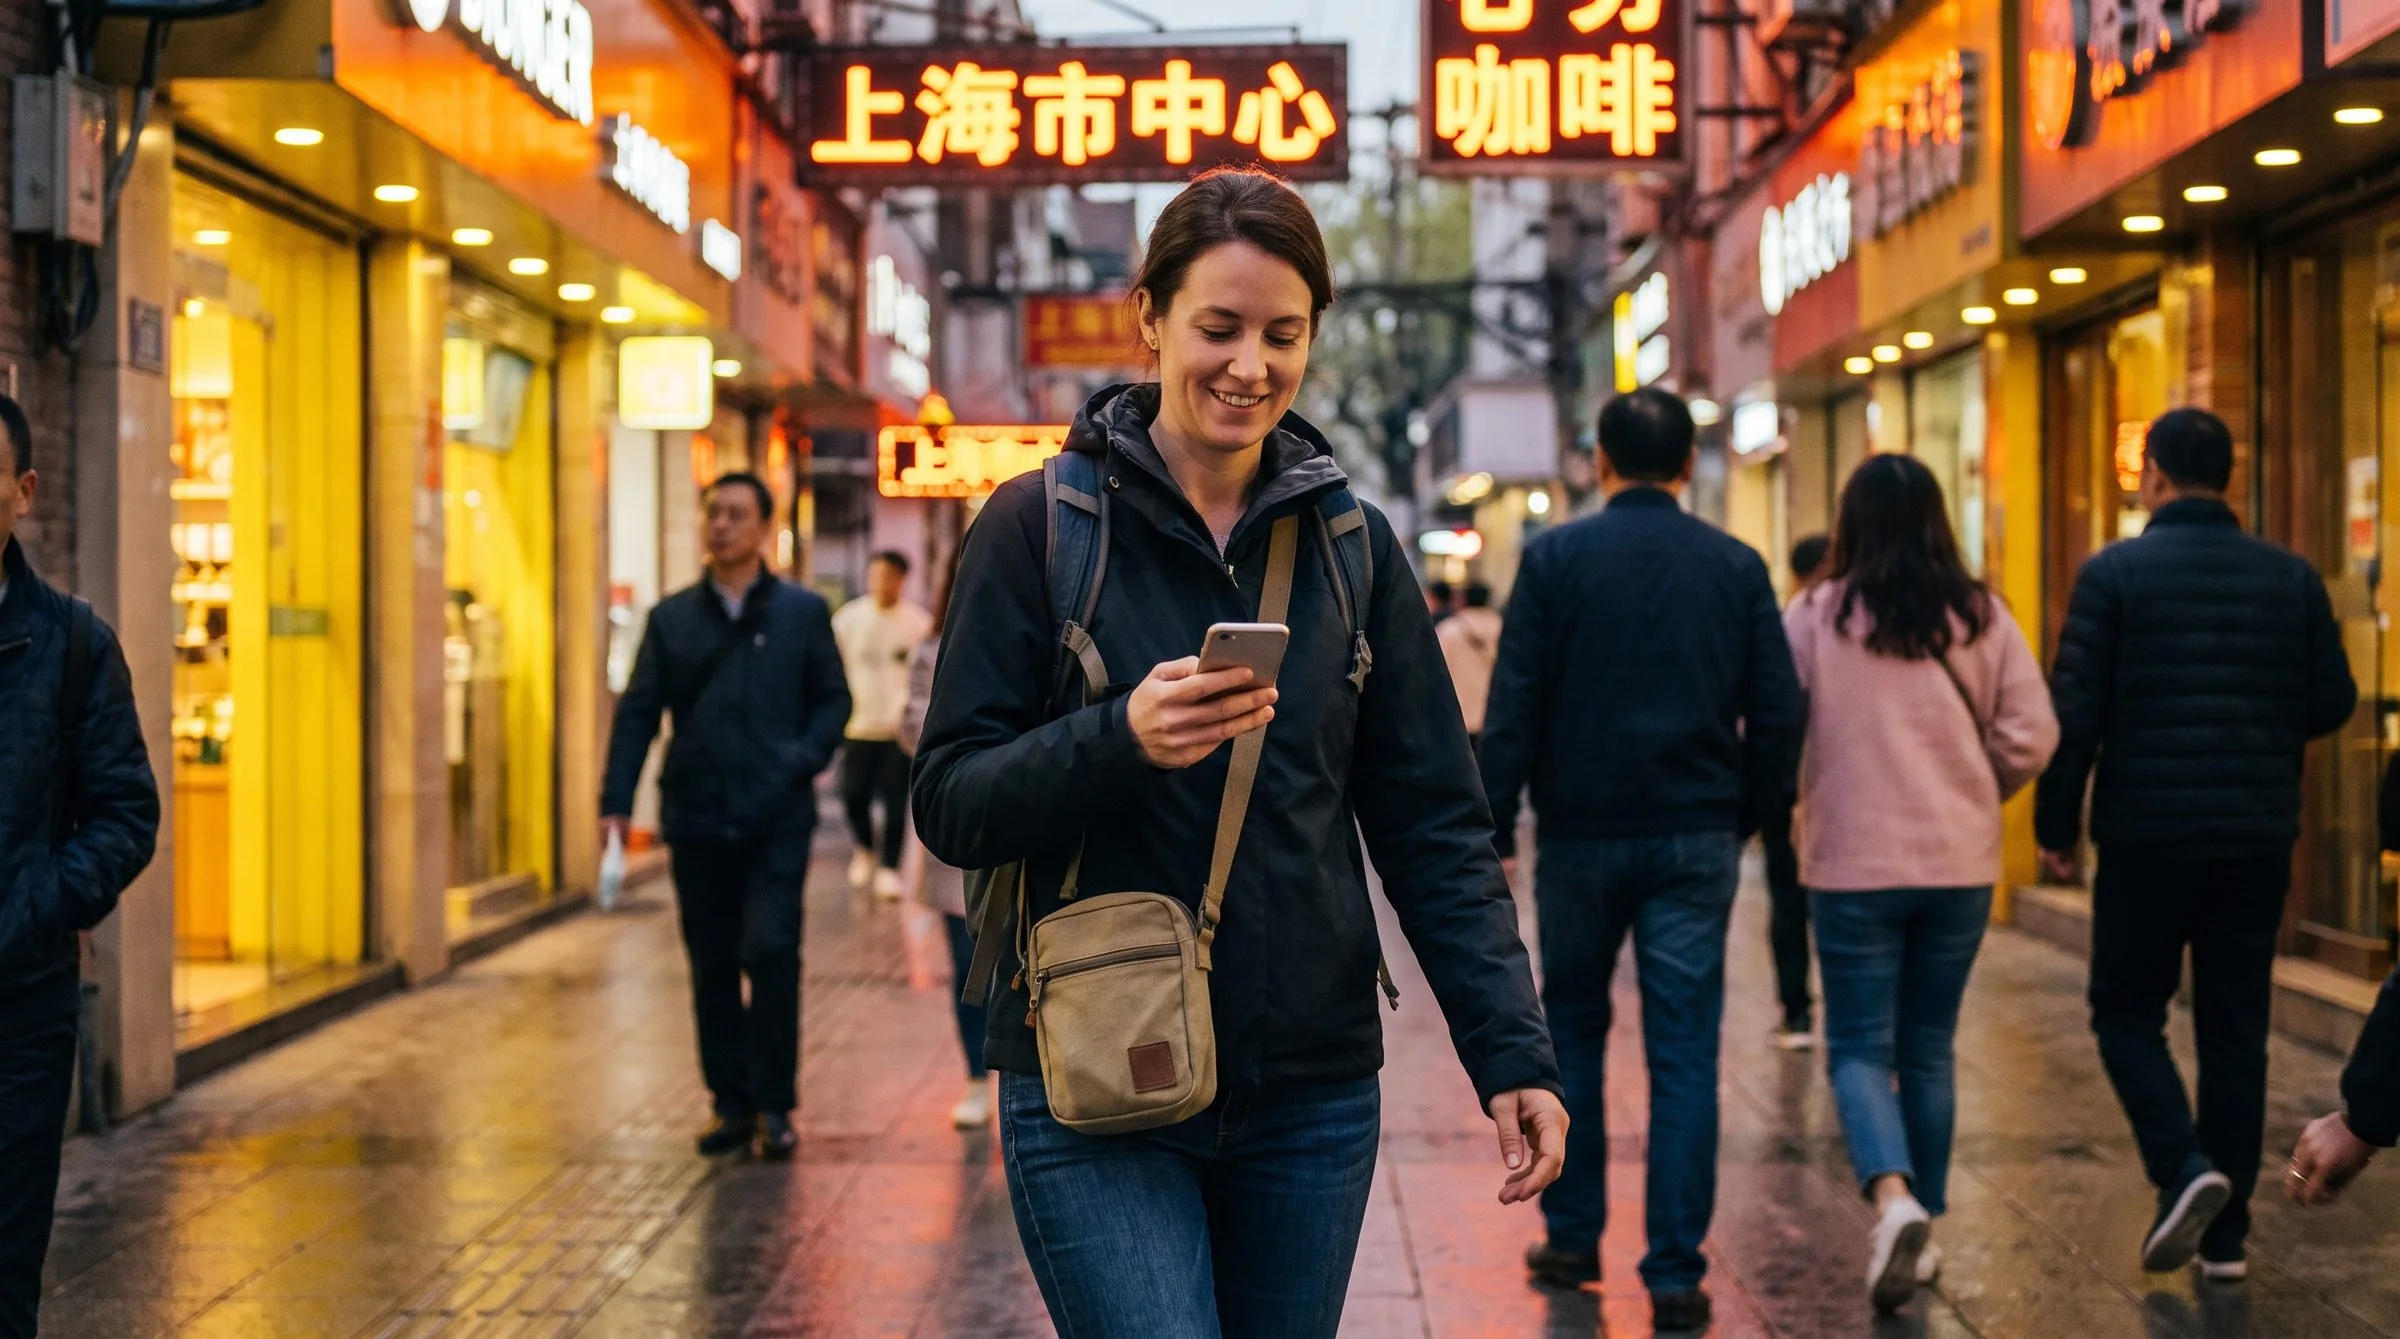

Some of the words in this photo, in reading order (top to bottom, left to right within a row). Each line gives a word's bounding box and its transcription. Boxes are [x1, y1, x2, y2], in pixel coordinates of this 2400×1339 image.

[811, 60, 1337, 166] 上海市中心
[1435, 43, 1677, 157] 咖啡
